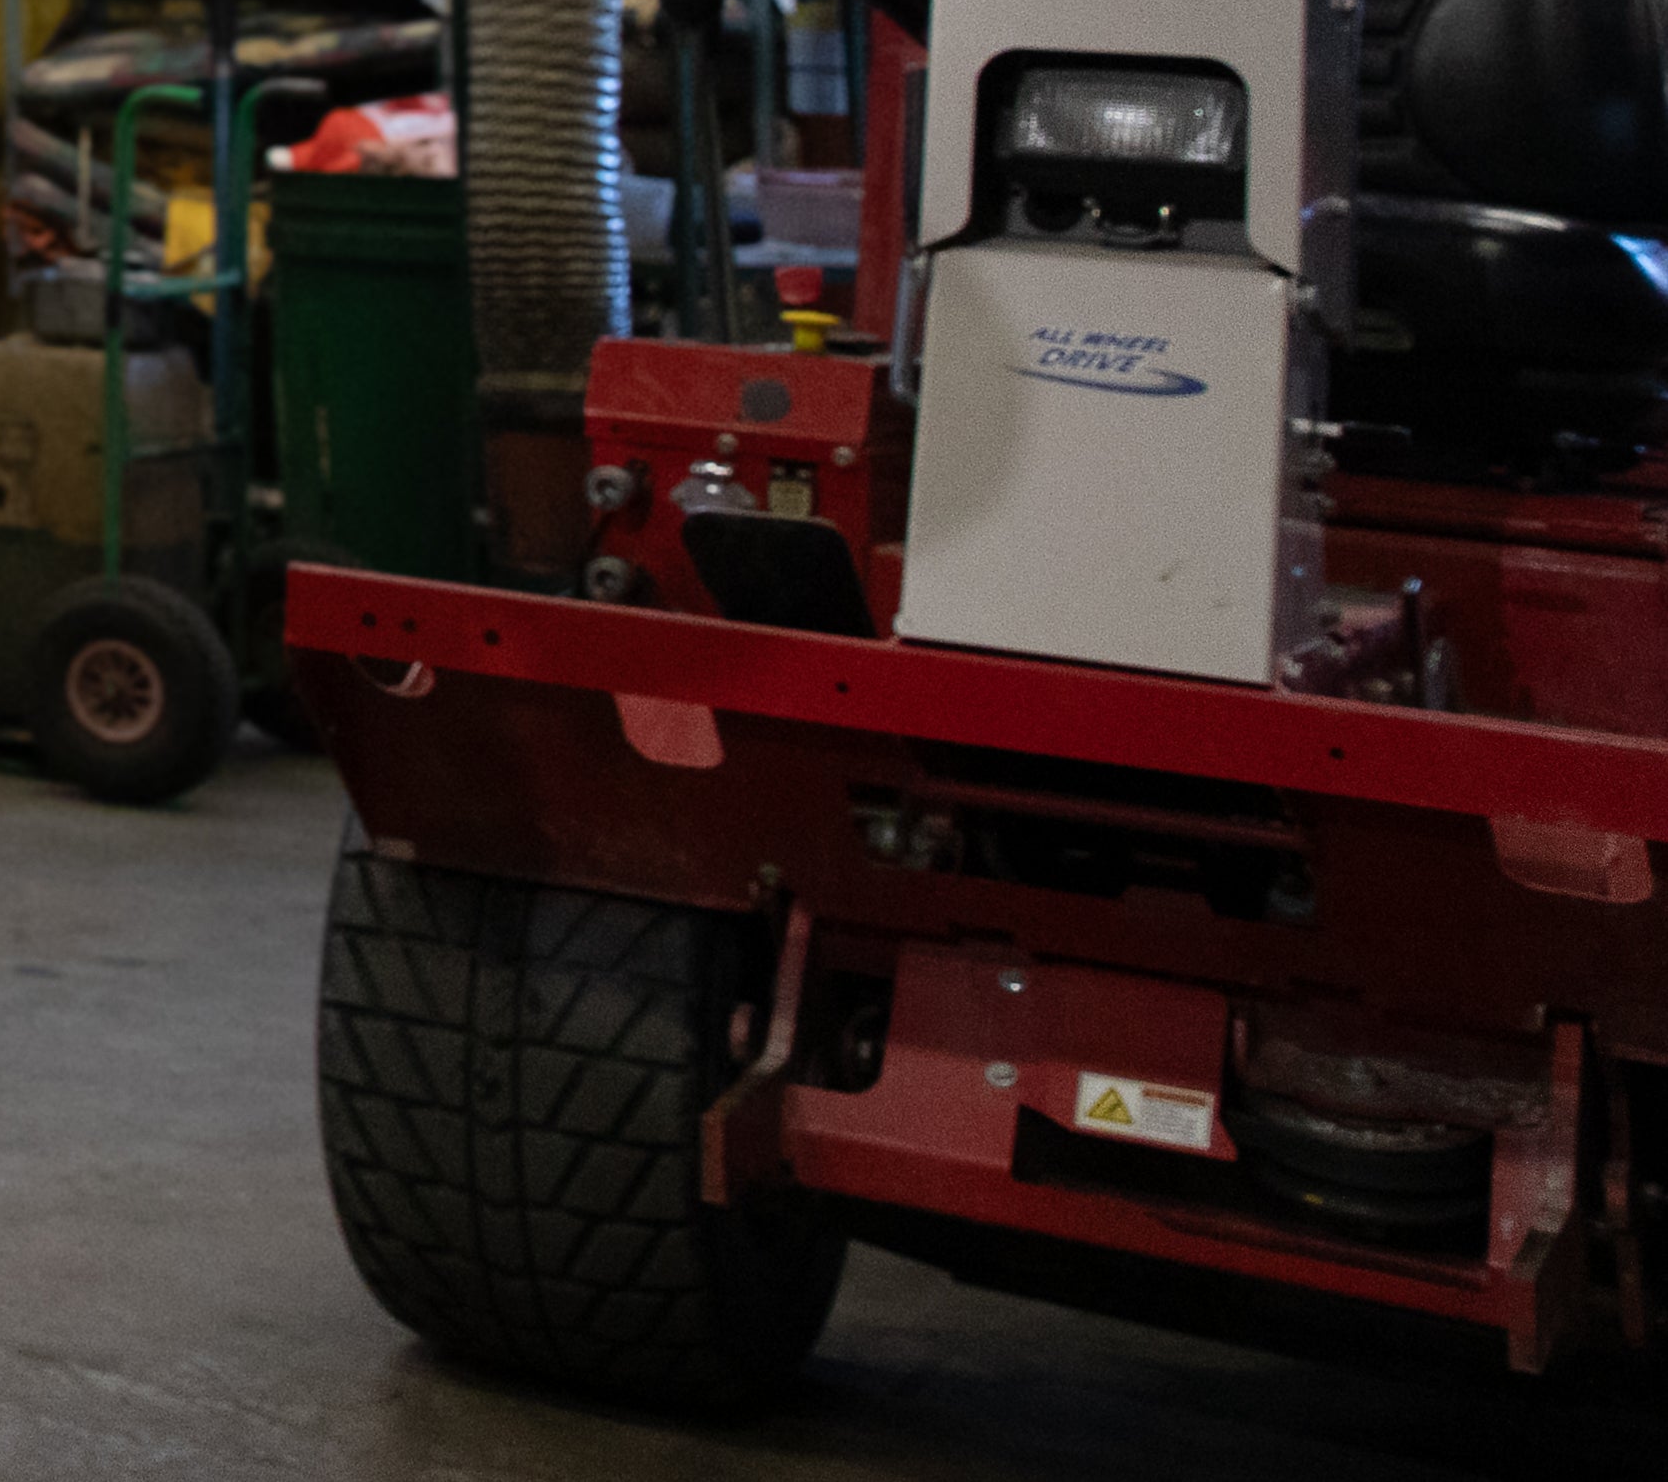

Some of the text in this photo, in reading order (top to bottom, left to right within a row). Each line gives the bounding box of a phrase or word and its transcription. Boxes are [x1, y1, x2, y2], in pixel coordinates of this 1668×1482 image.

[1031, 327, 1170, 352] ALL WHEEL
[1039, 348, 1144, 373] DRIVE
